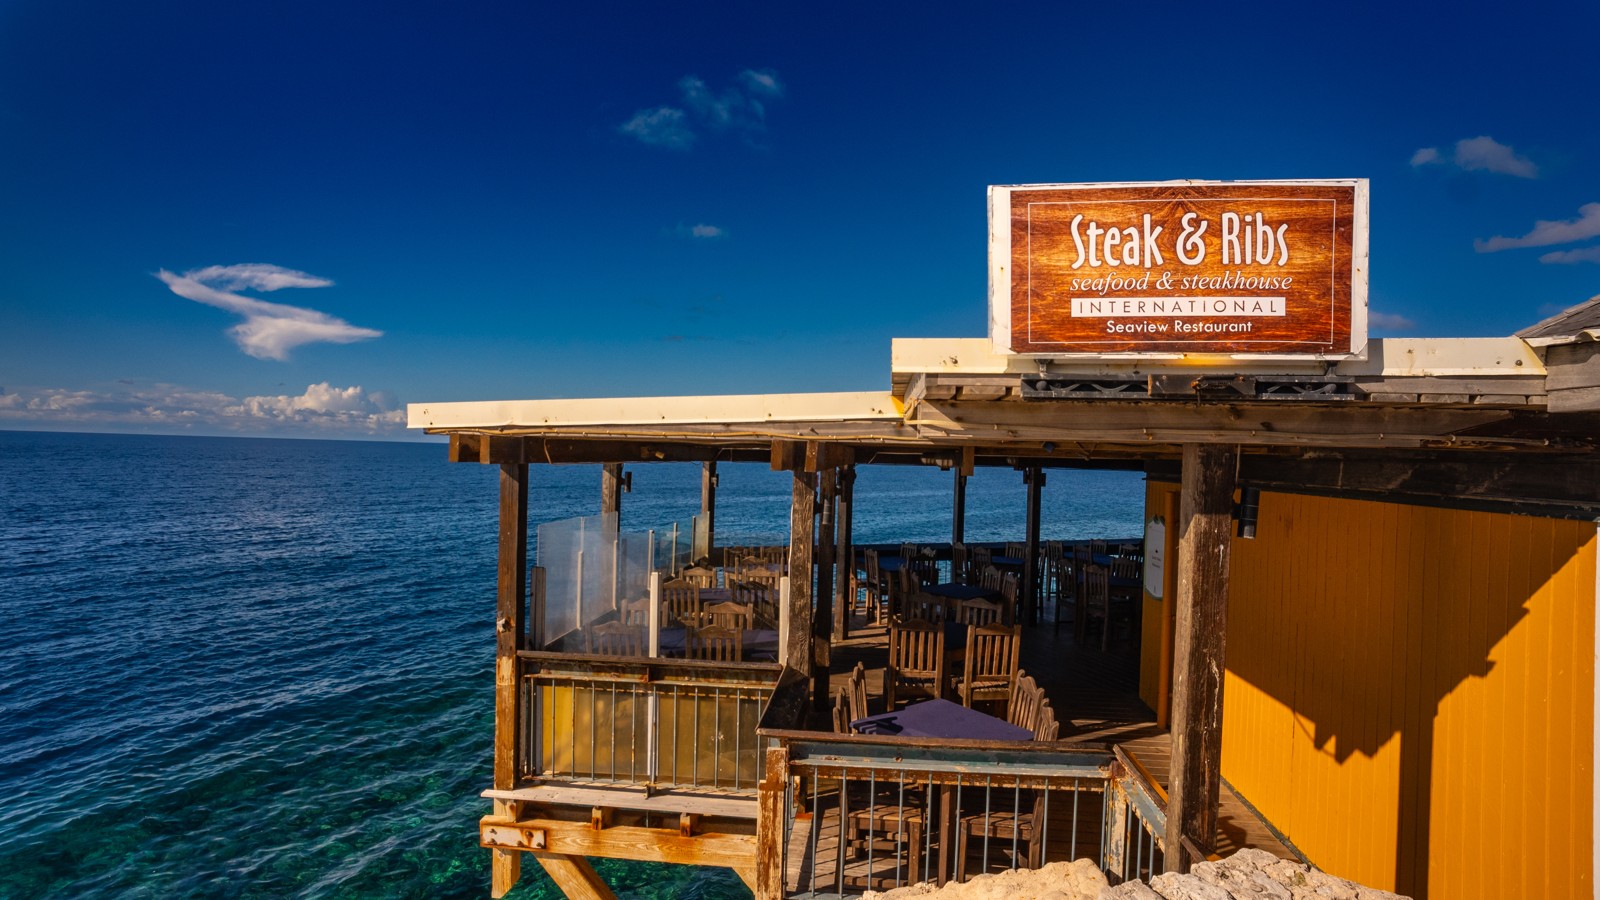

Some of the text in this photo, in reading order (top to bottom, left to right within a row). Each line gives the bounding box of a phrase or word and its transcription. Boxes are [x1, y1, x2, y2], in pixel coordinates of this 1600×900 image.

[1070, 212, 1289, 269] Steak & Ribs
[1070, 270, 1293, 295] seafood & steakhouse
[1079, 300, 1277, 314] INTERNATIONAL
[1106, 320, 1253, 333] Seaview Restaurant
